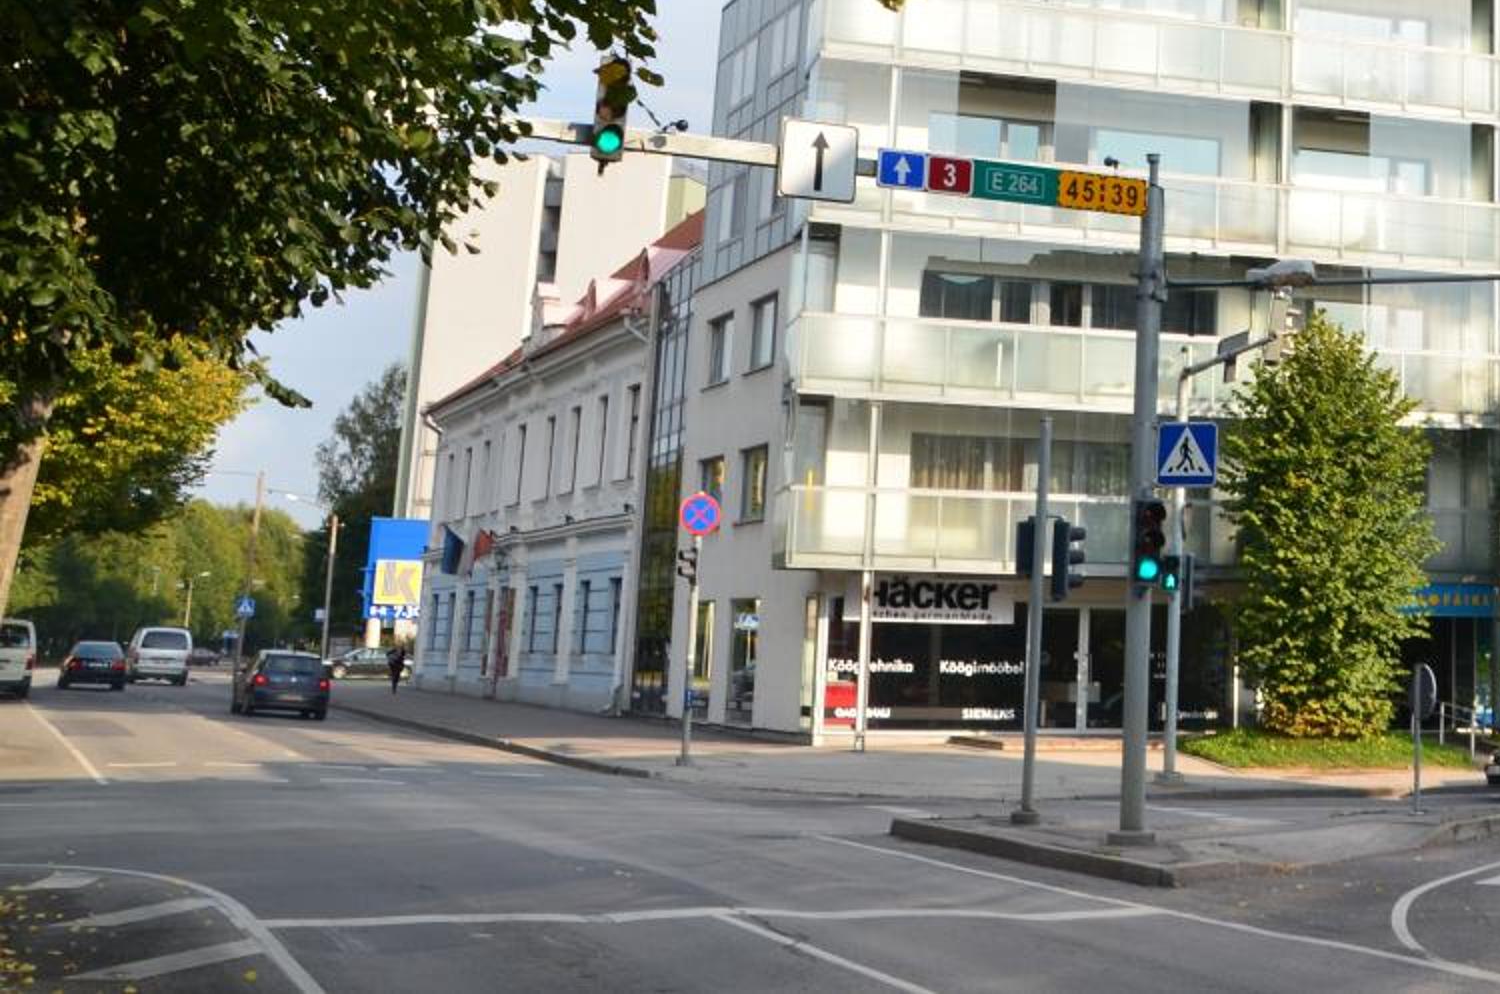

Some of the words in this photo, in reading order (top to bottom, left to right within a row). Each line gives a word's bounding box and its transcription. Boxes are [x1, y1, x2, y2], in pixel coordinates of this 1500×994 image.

[943, 164, 957, 187] 3
[991, 173, 1003, 191] E
[1008, 174, 1039, 194] 264
[1066, 179, 1094, 203] 45
[1111, 185, 1138, 207] 39
[828, 659, 914, 675] Köögehnika
[961, 708, 1016, 719] SIEMENS
